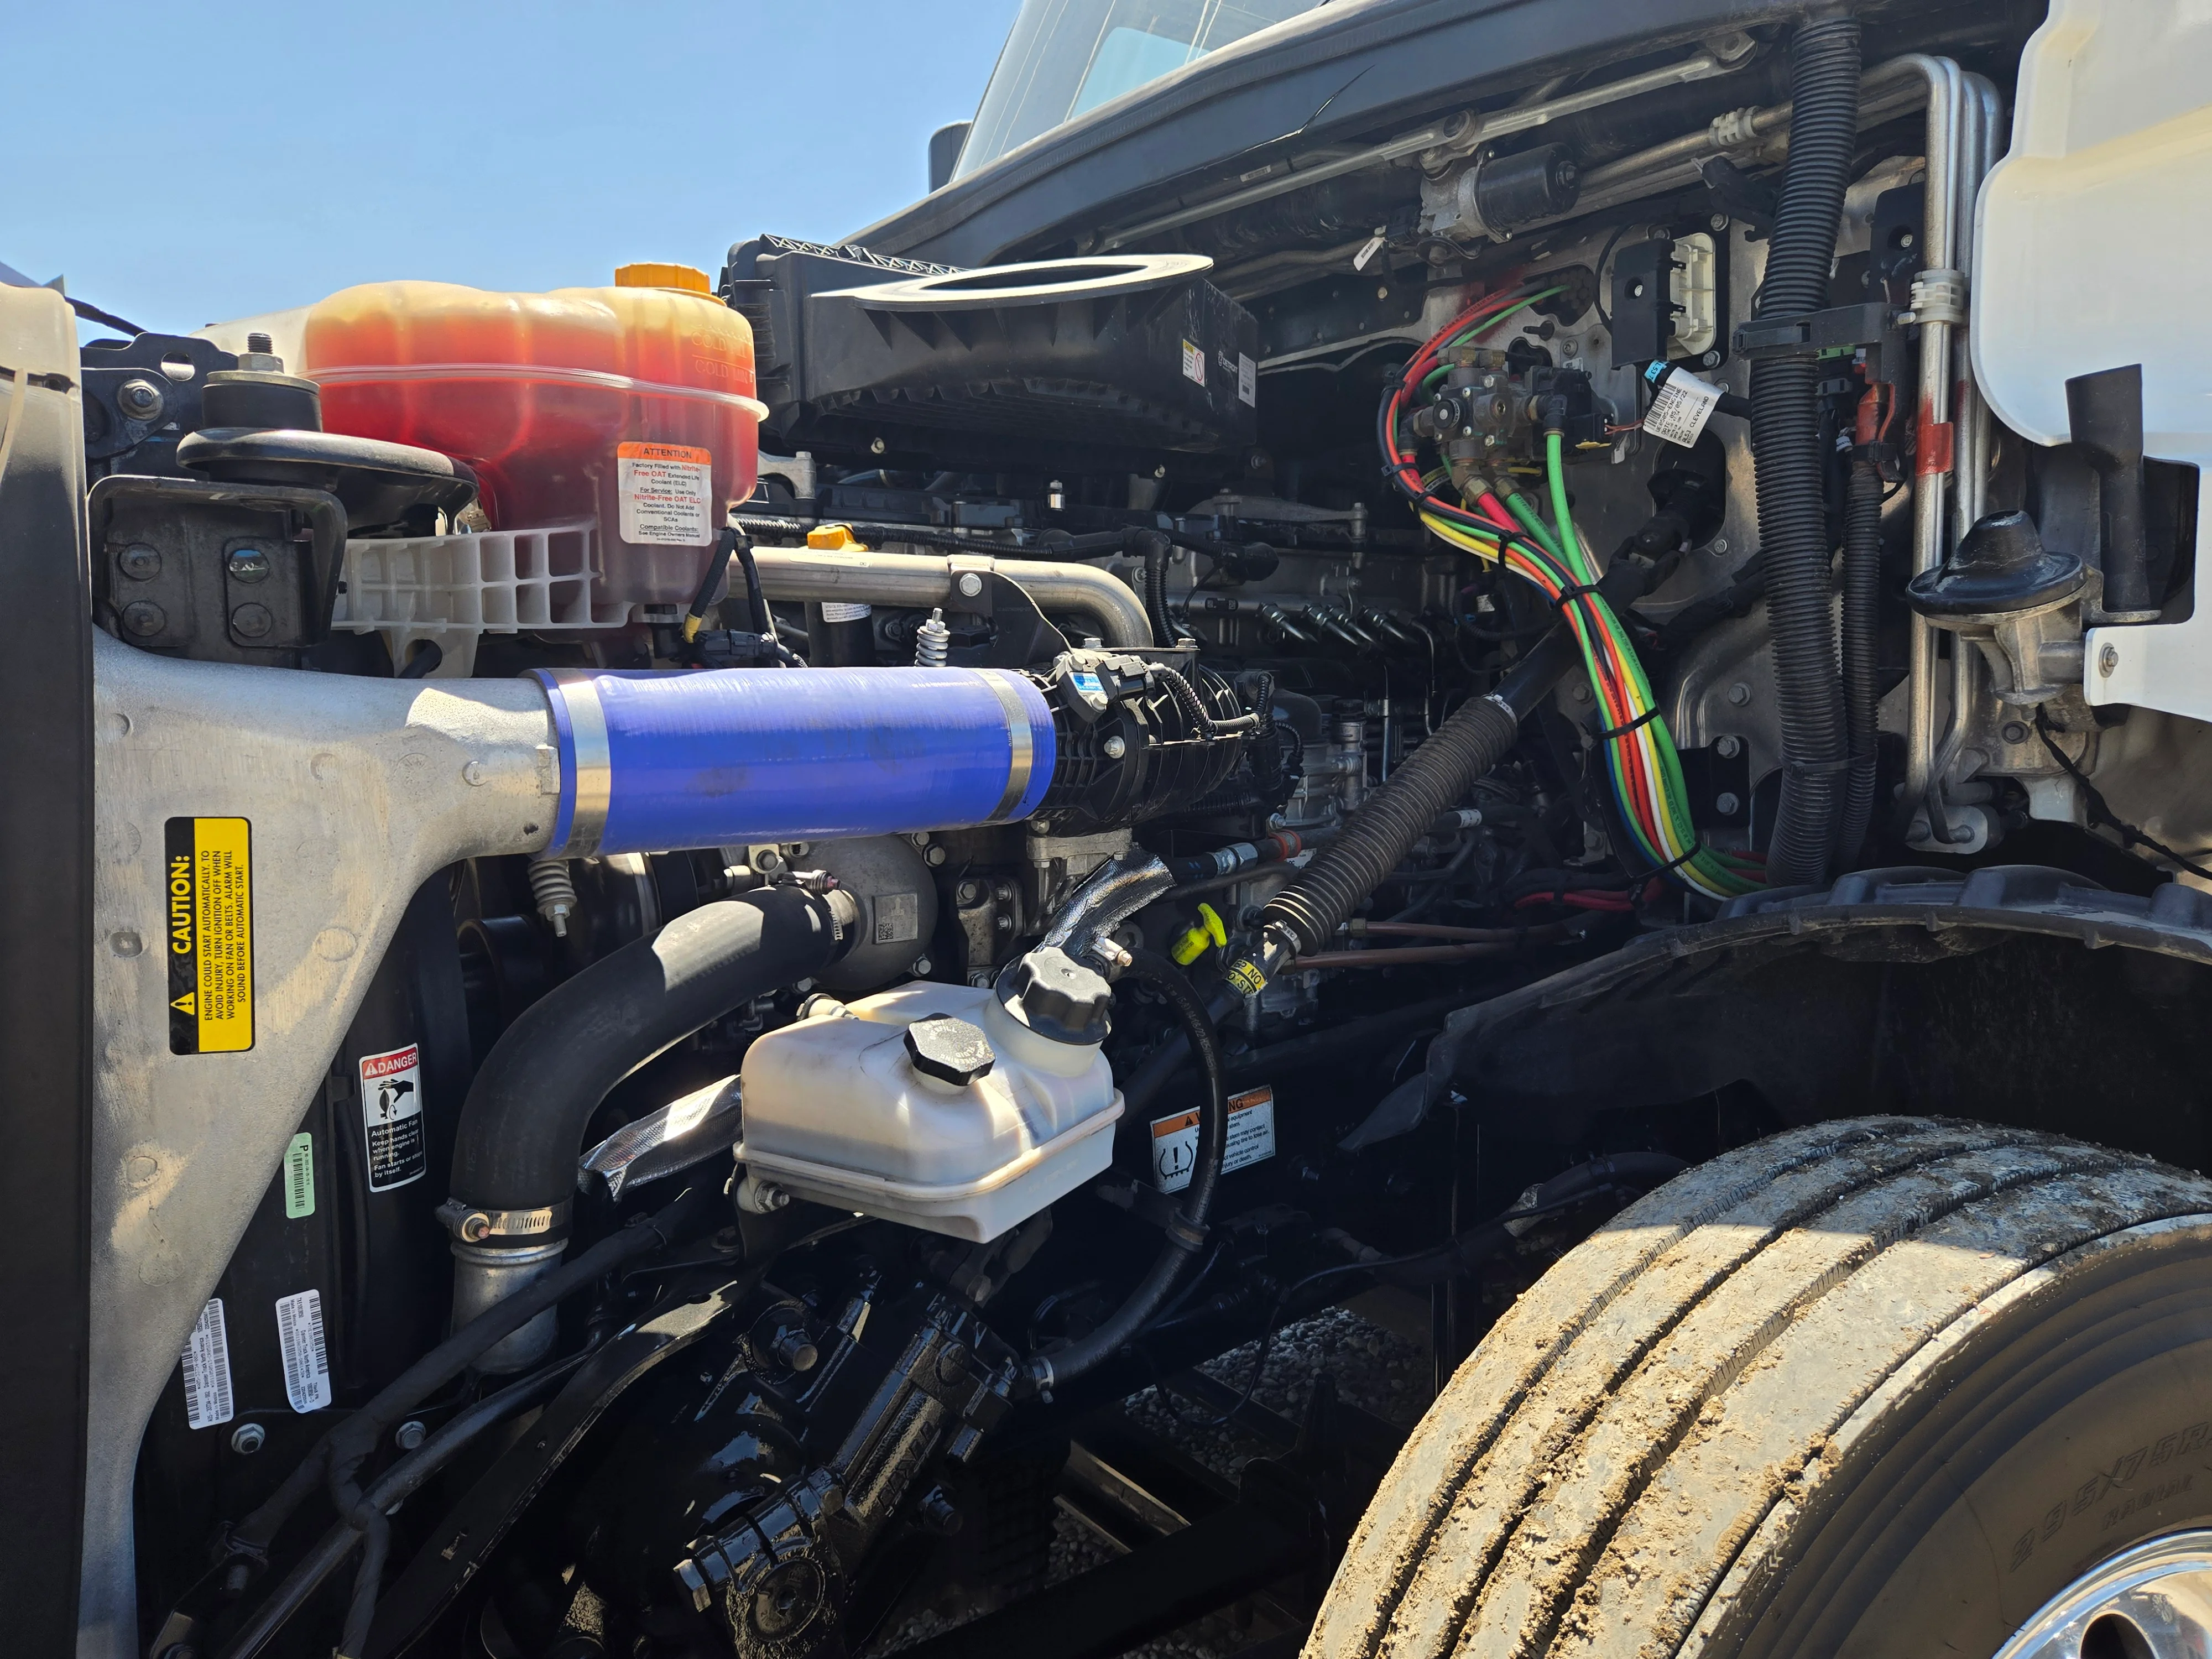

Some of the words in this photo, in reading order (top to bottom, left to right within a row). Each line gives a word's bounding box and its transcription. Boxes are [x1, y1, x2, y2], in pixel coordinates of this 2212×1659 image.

[691, 332, 726, 351] COLD
[695, 359, 728, 378] COLD
[1223, 357, 1238, 374] DETROIT
[1682, 430, 1691, 443] AL53
[1689, 396, 1709, 428] CLEVELAND
[644, 448, 692, 458] ATTENTION
[201, 850, 210, 862] TO
[212, 851, 221, 877] WHEN
[223, 851, 232, 869] WILL
[224, 872, 232, 899] ALARM
[235, 864, 244, 889] START.
[213, 879, 221, 894] OFF
[171, 855, 191, 954] CAUTION:
[201, 864, 211, 931] AUTOMATICALLY.
[213, 897, 222, 935] IGNITION
[225, 902, 233, 926] BELTS.
[236, 891, 244, 938] AUTOMATIC
[225, 929, 233, 941] OR
[203, 935, 211, 957] START
[215, 938, 223, 959] TURN
[226, 943, 234, 959] FAN
[237, 941, 245, 971] BEFORE
[204, 959, 212, 987] COULD
[215, 961, 225, 992] INJURY,
[226, 962, 234, 975] ON
[1247, 968, 1261, 985] NO
[237, 973, 246, 1003] SOUND
[204, 990, 213, 1020] ENGINE
[215, 994, 223, 1020] AVOID
[226, 978, 235, 1020] WORKING
[929, 1026, 958, 1040] OVERFILL
[956, 1046, 975, 1058] FLUID
[976, 1040, 985, 1059] POWER
[378, 1052, 417, 1074] DANGER
[940, 1053, 978, 1065] STEERING
[1230, 1109, 1252, 1121] equipment
[371, 1123, 408, 1137] Automatic
[390, 1134, 408, 1143] hands
[408, 1129, 419, 1137] clear
[1250, 1124, 1265, 1134] contact
[372, 1146, 390, 1154] when
[391, 1140, 410, 1150] engine
[1225, 1140, 1240, 1149] ausing
[1229, 1150, 1244, 1159] vehicle
[1244, 1145, 1259, 1154] control
[373, 1151, 399, 1161] running.
[387, 1159, 405, 1168] starts
[412, 1151, 422, 1159] stops
[1222, 1160, 1233, 1169] njury
[384, 1167, 401, 1176] itself.
[2010, 1421, 2212, 1574] 295/75R
